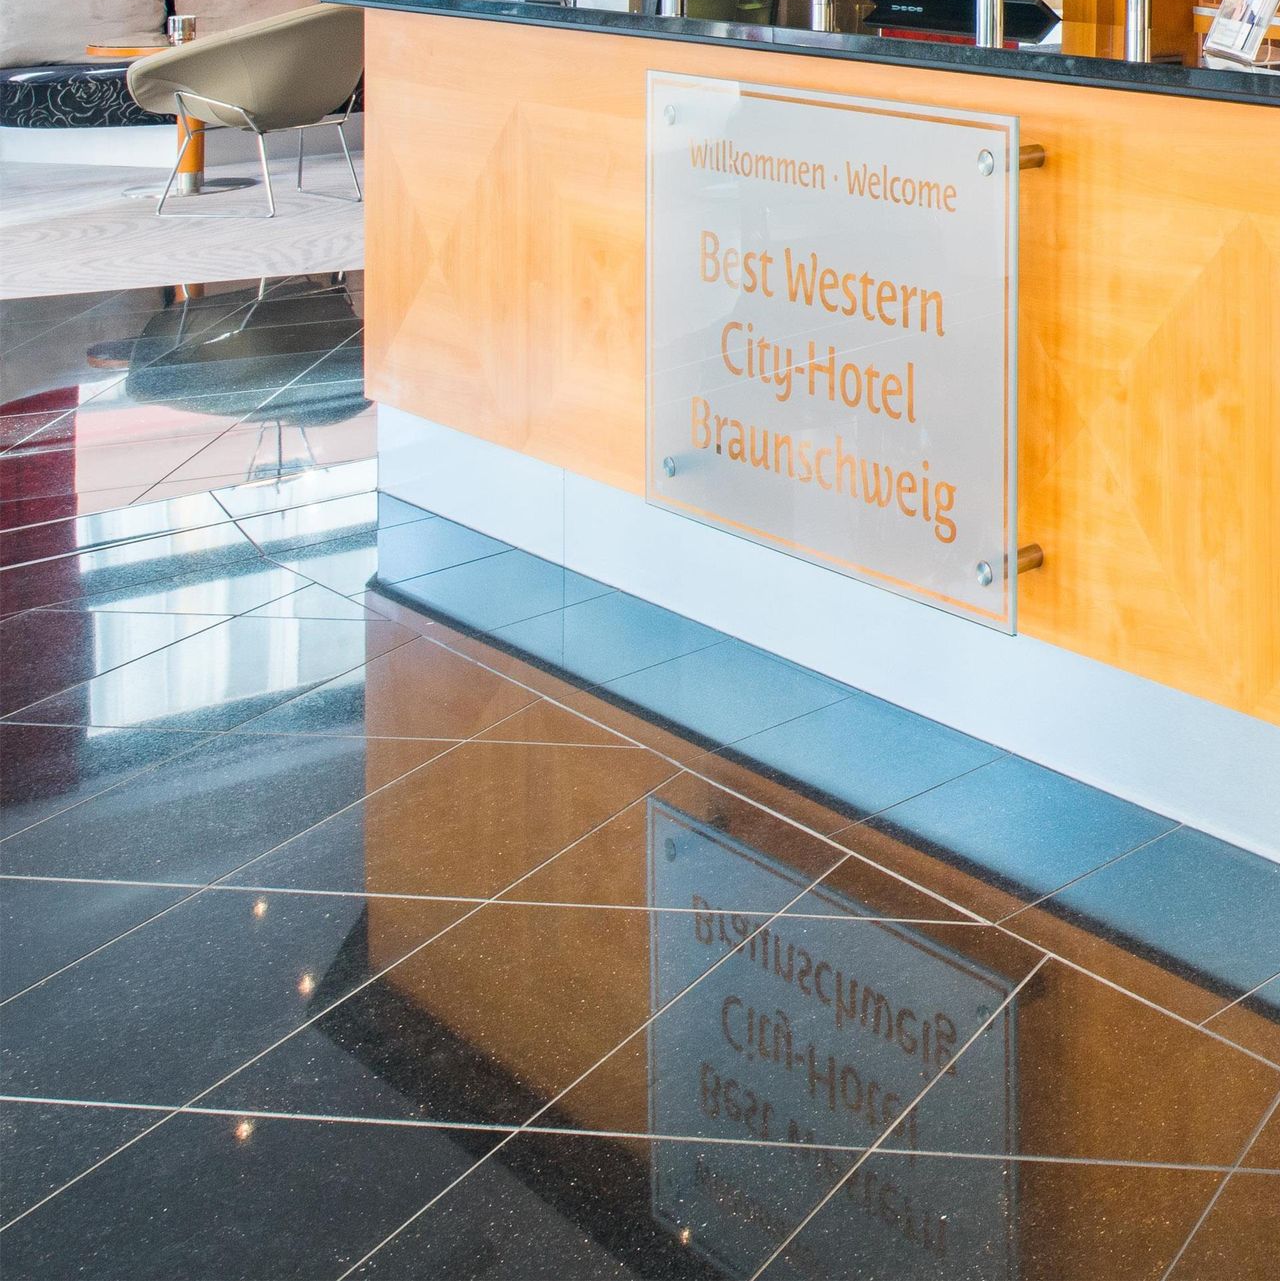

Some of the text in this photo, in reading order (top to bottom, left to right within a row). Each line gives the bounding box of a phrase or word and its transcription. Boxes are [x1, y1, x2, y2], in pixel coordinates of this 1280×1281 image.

[688, 138, 957, 213] Willkommen Welcome
[701, 230, 946, 337] Best Western
[721, 321, 917, 424] City-Hotel
[690, 396, 957, 544] Braunschweig
